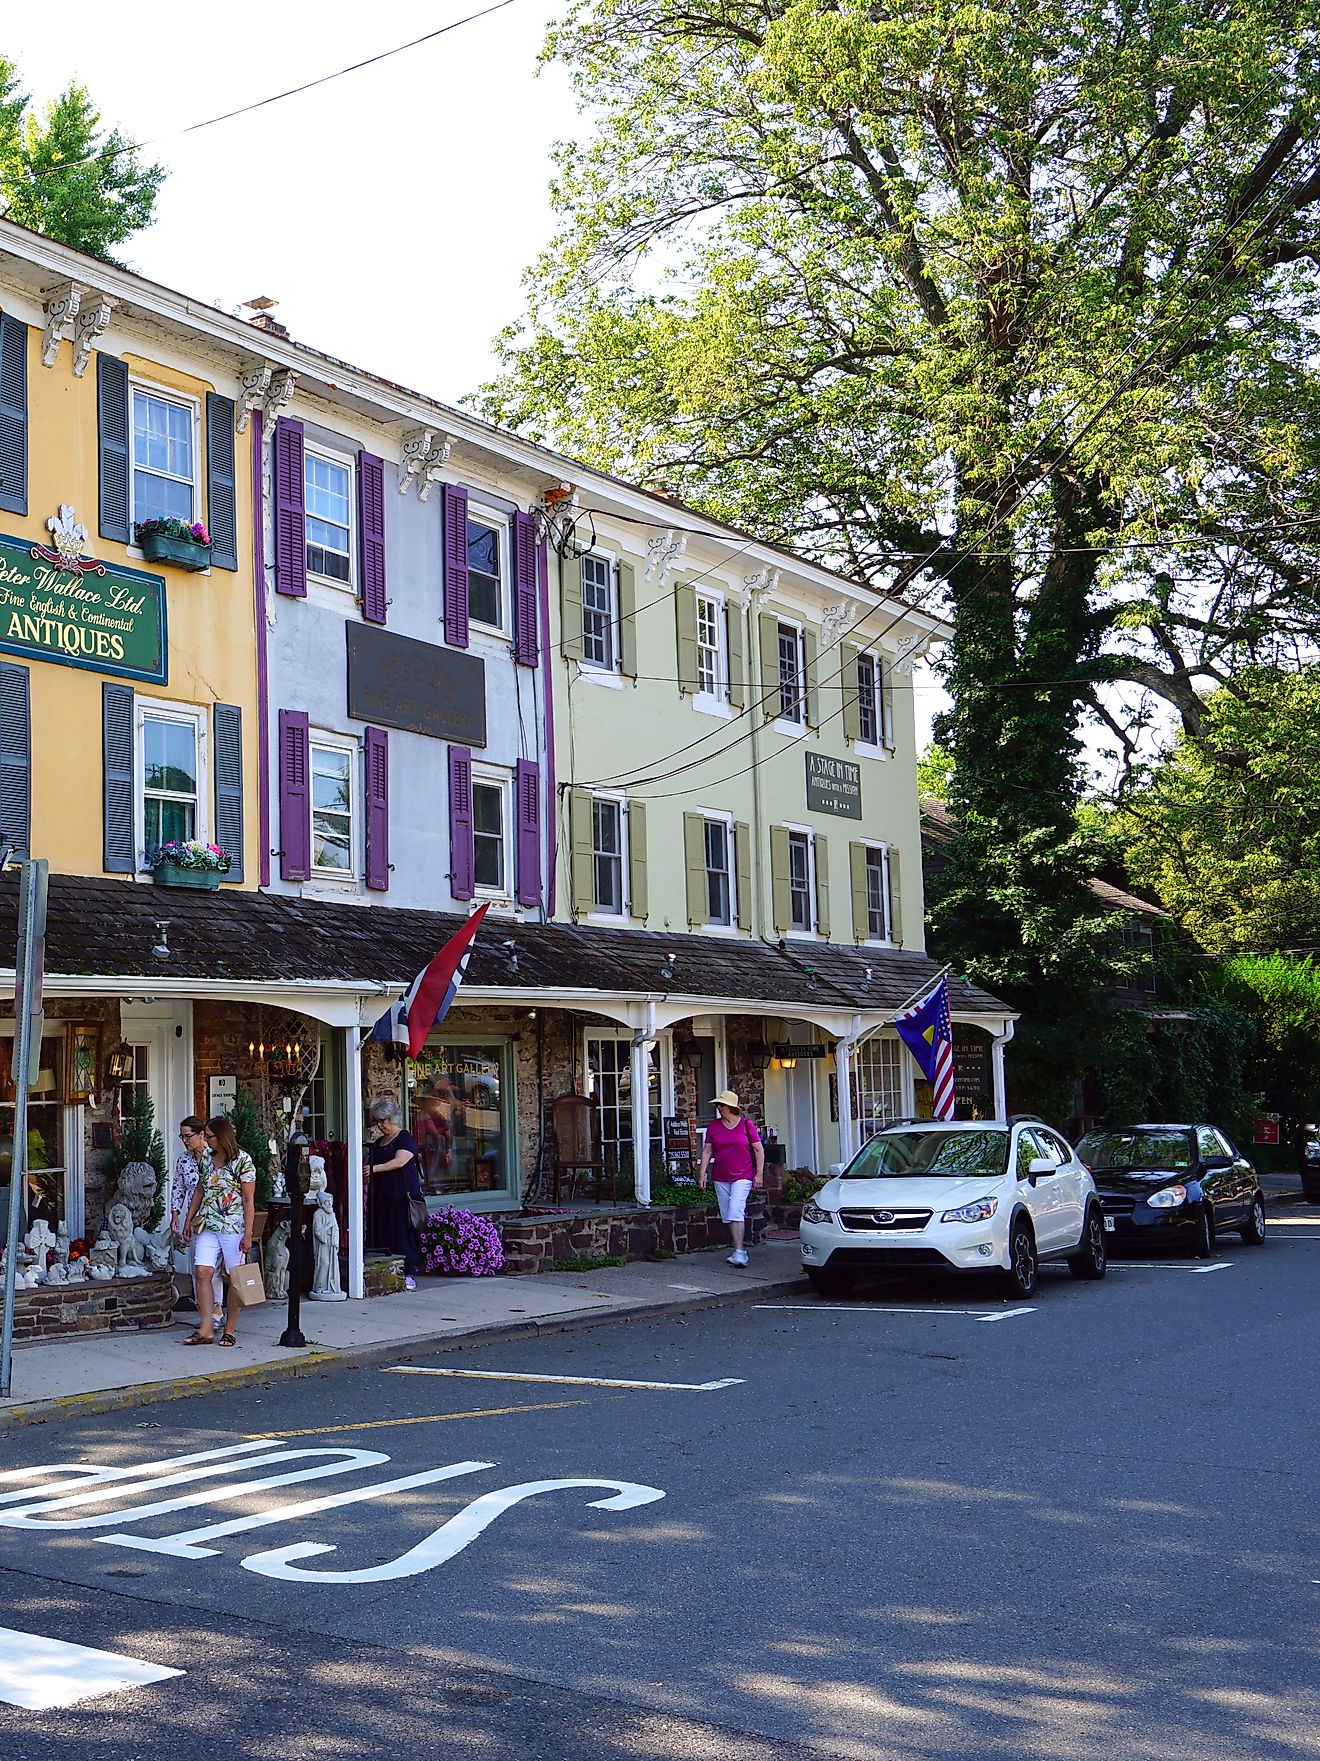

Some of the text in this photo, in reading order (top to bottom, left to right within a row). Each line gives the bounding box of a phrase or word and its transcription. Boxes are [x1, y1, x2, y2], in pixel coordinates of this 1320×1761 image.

[33, 566, 102, 604] Wallace
[105, 586, 144, 615] Ltd.
[30, 592, 65, 619] English
[68, 605, 79, 621] &
[81, 603, 134, 633] Continental
[6, 612, 125, 660] ANTIQUES
[810, 756, 858, 783] A STAGE IN TIME
[434, 1063, 454, 1074] ART
[955, 1096, 973, 1105] PEN
